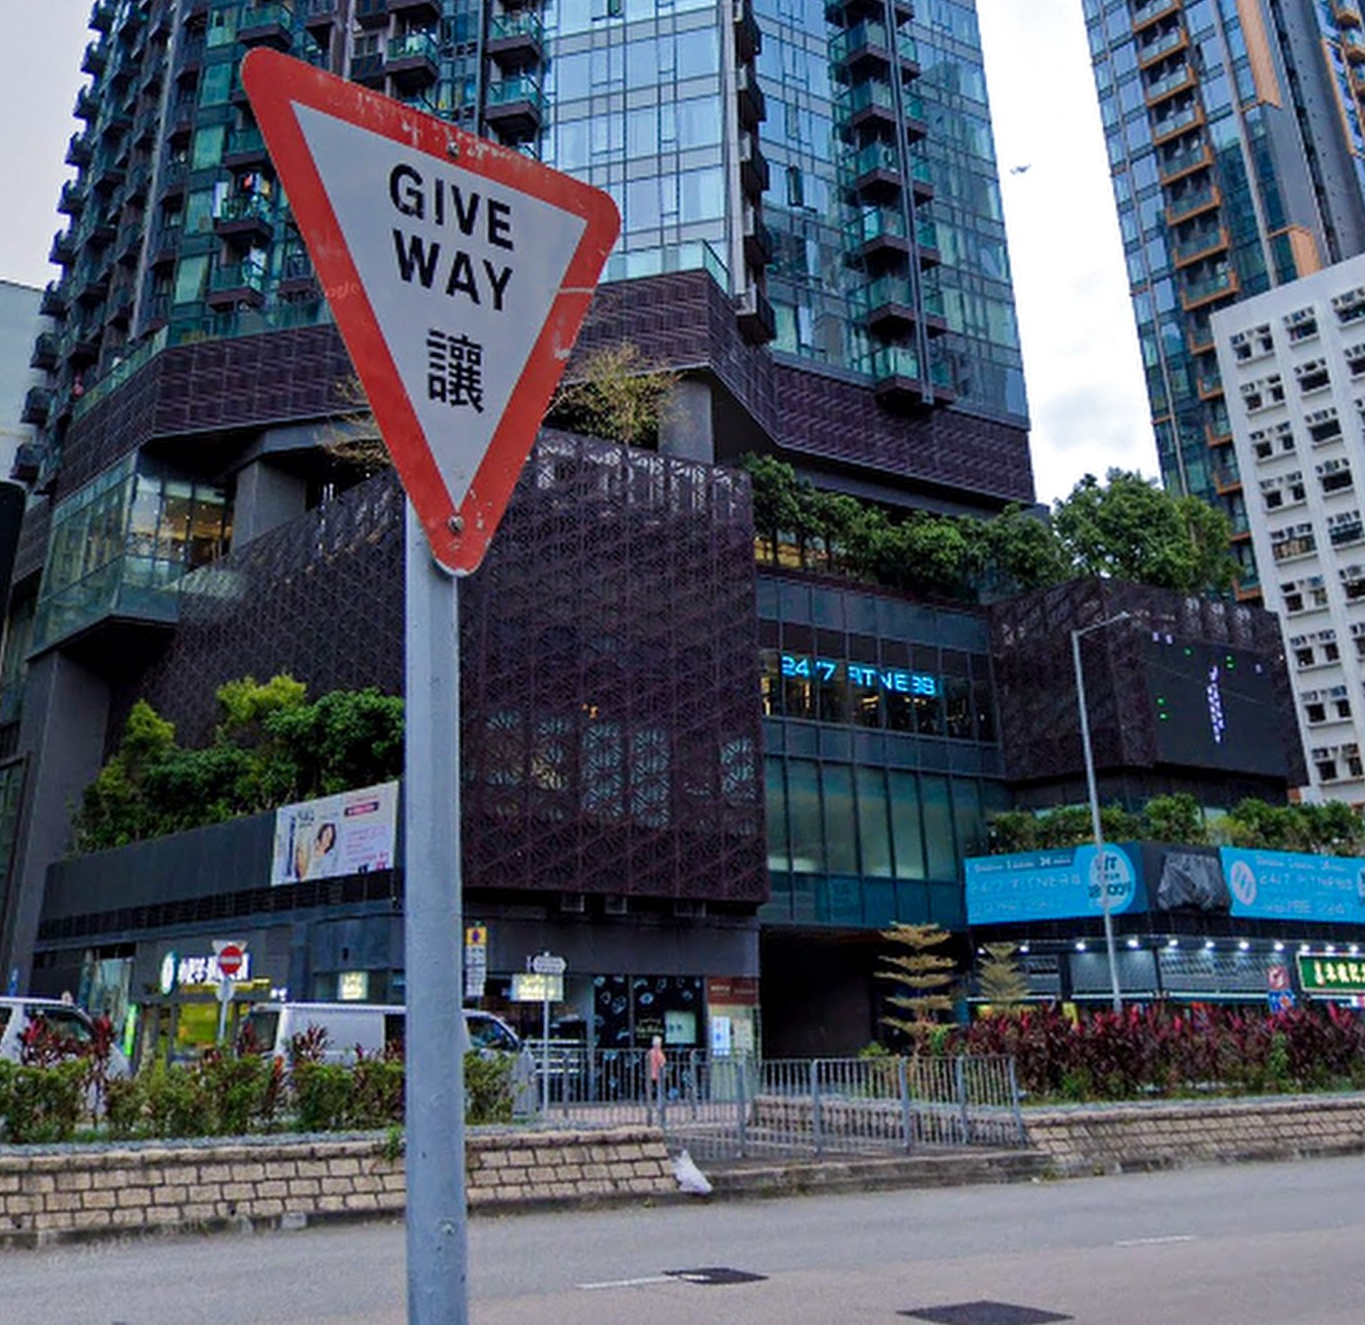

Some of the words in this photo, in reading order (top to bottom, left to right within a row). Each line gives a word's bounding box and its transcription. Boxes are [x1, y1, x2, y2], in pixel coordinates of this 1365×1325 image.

[389, 163, 514, 252] GIVE
[392, 228, 513, 312] WAY
[426, 329, 486, 415] 讓
